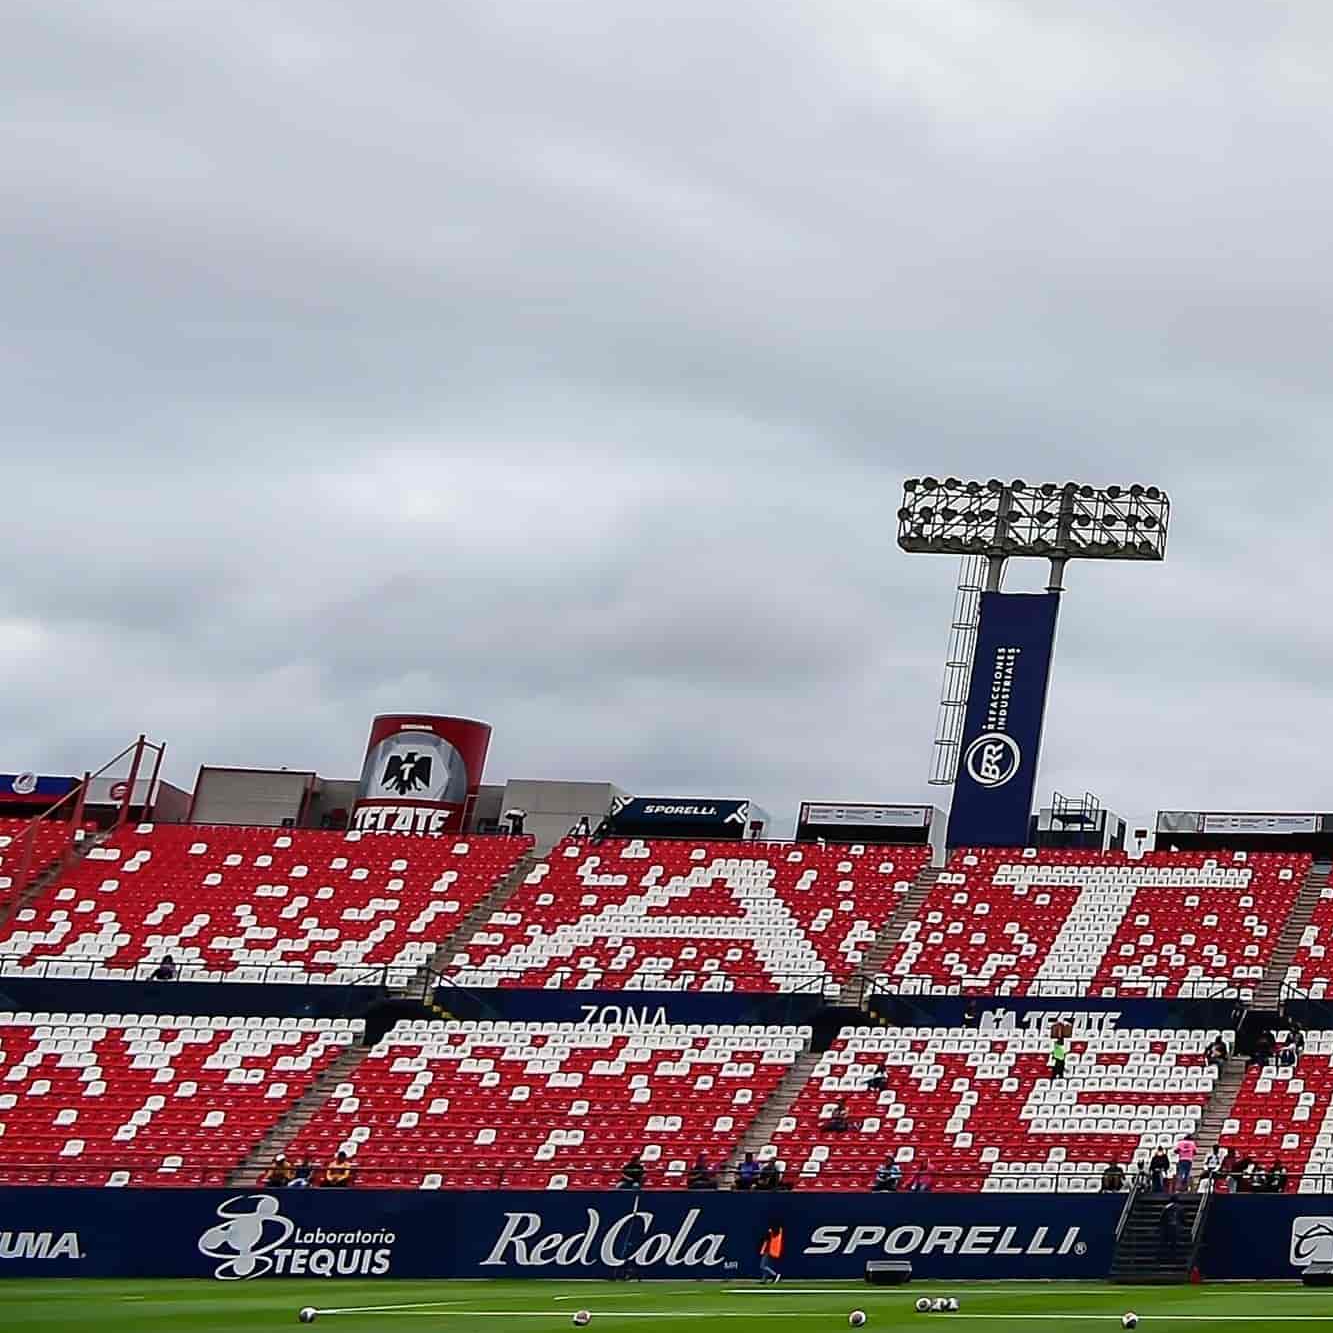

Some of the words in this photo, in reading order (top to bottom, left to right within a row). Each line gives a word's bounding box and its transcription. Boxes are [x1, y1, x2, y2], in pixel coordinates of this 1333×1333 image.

[987, 647, 1006, 730] REFACCIONES
[996, 647, 1016, 730] INDUSTRIALES
[354, 806, 452, 831] TECATE
[580, 1005, 667, 1026] ZONA
[0, 1232, 80, 1258] UMA
[294, 1227, 395, 1245] Laboratorio
[273, 1249, 392, 1276] TEQUIS
